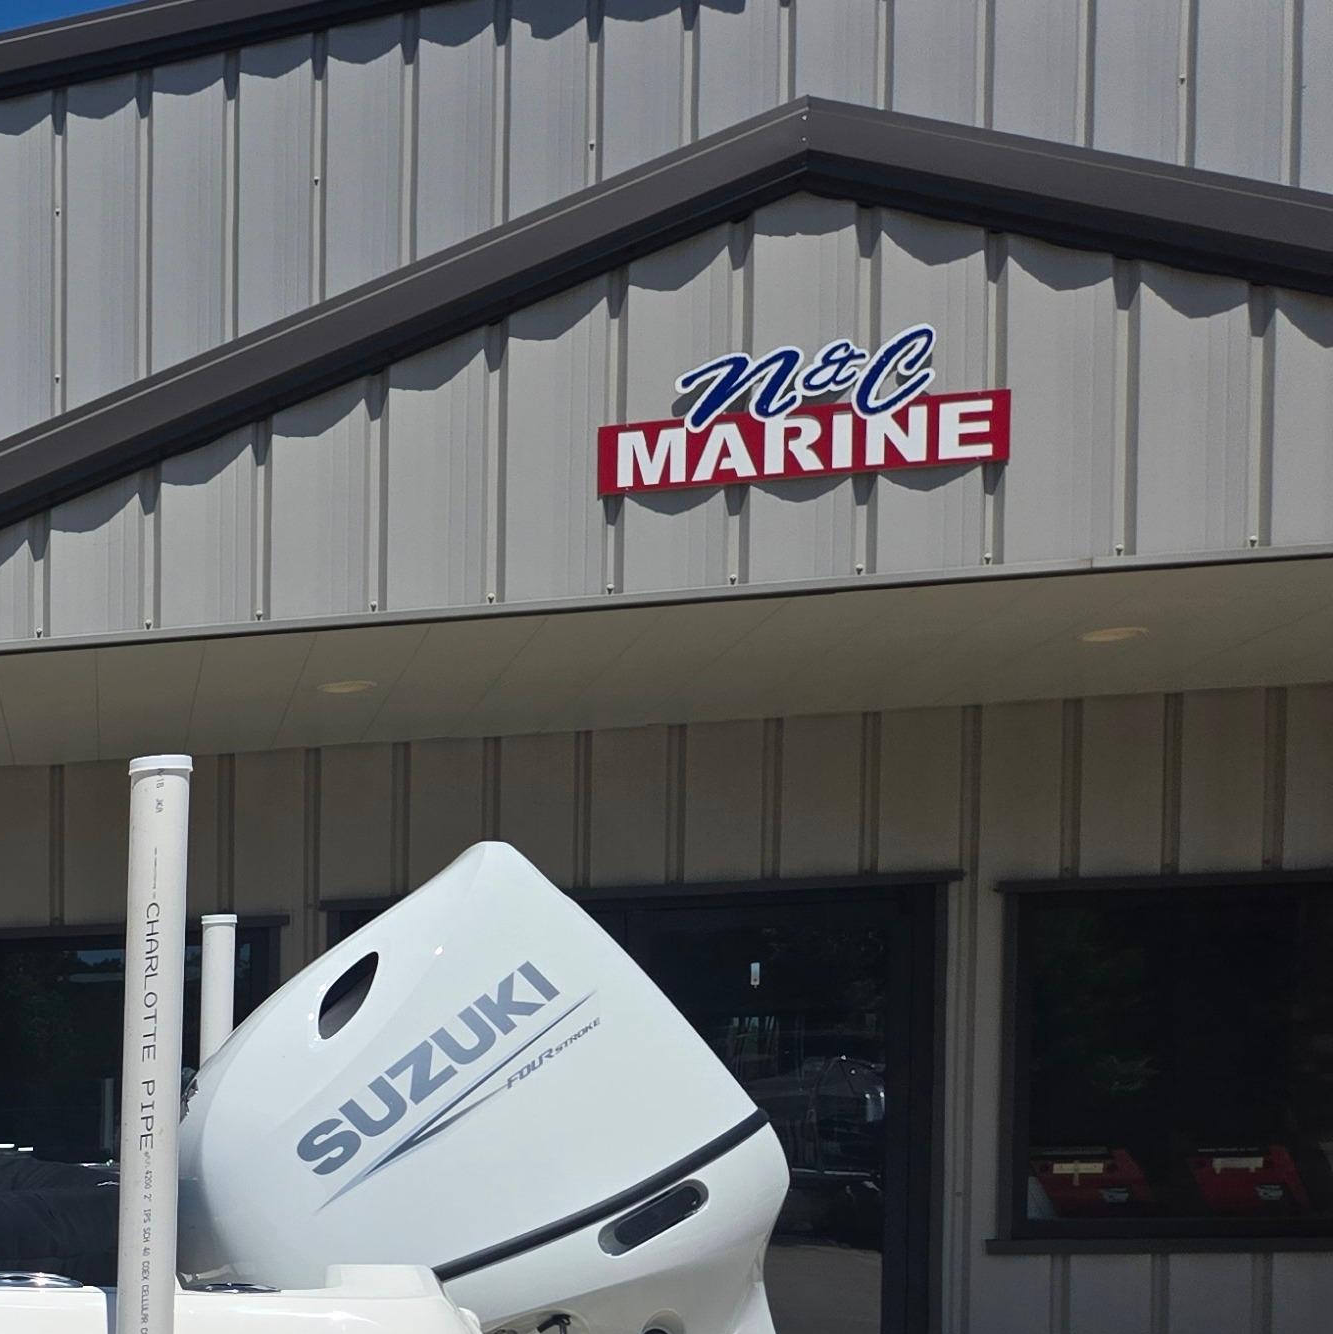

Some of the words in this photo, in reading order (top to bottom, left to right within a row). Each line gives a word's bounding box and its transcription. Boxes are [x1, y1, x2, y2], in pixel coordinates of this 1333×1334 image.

[616, 399, 994, 488] MARINE
[141, 902, 160, 1063] CHARLOTTE
[296, 961, 560, 1175] SUZUKI
[139, 1080, 156, 1151] PIPE
[142, 1227, 151, 1243] SCH
[140, 1284, 150, 1324] CELLULAR
